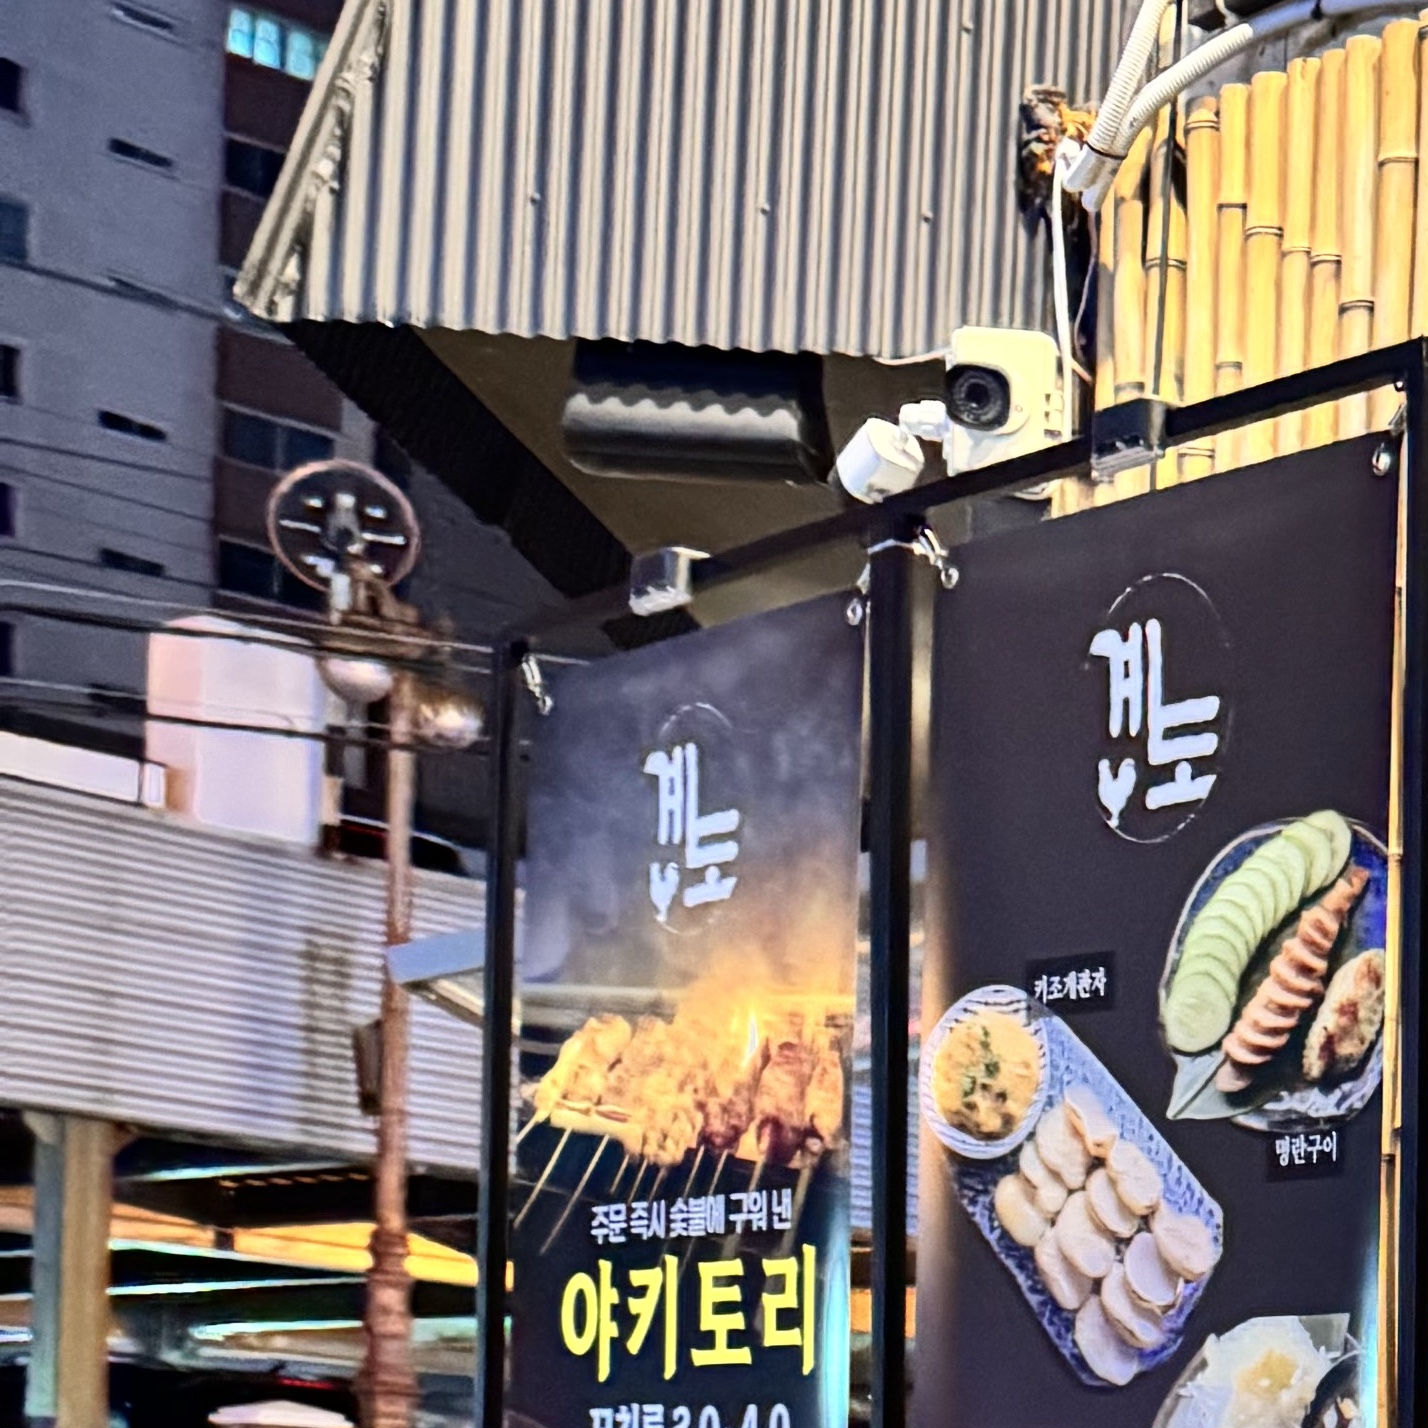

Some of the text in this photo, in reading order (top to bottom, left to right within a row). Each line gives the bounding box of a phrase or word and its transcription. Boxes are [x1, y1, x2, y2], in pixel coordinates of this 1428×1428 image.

[1034, 966, 1107, 1005] 키조개관자
[1274, 1130, 1337, 1168] 명란구이
[590, 1203, 627, 1245] 주문
[630, 1199, 666, 1240] 즉시
[669, 1194, 725, 1237] 숯불에
[561, 1243, 816, 1383] 야키토리
